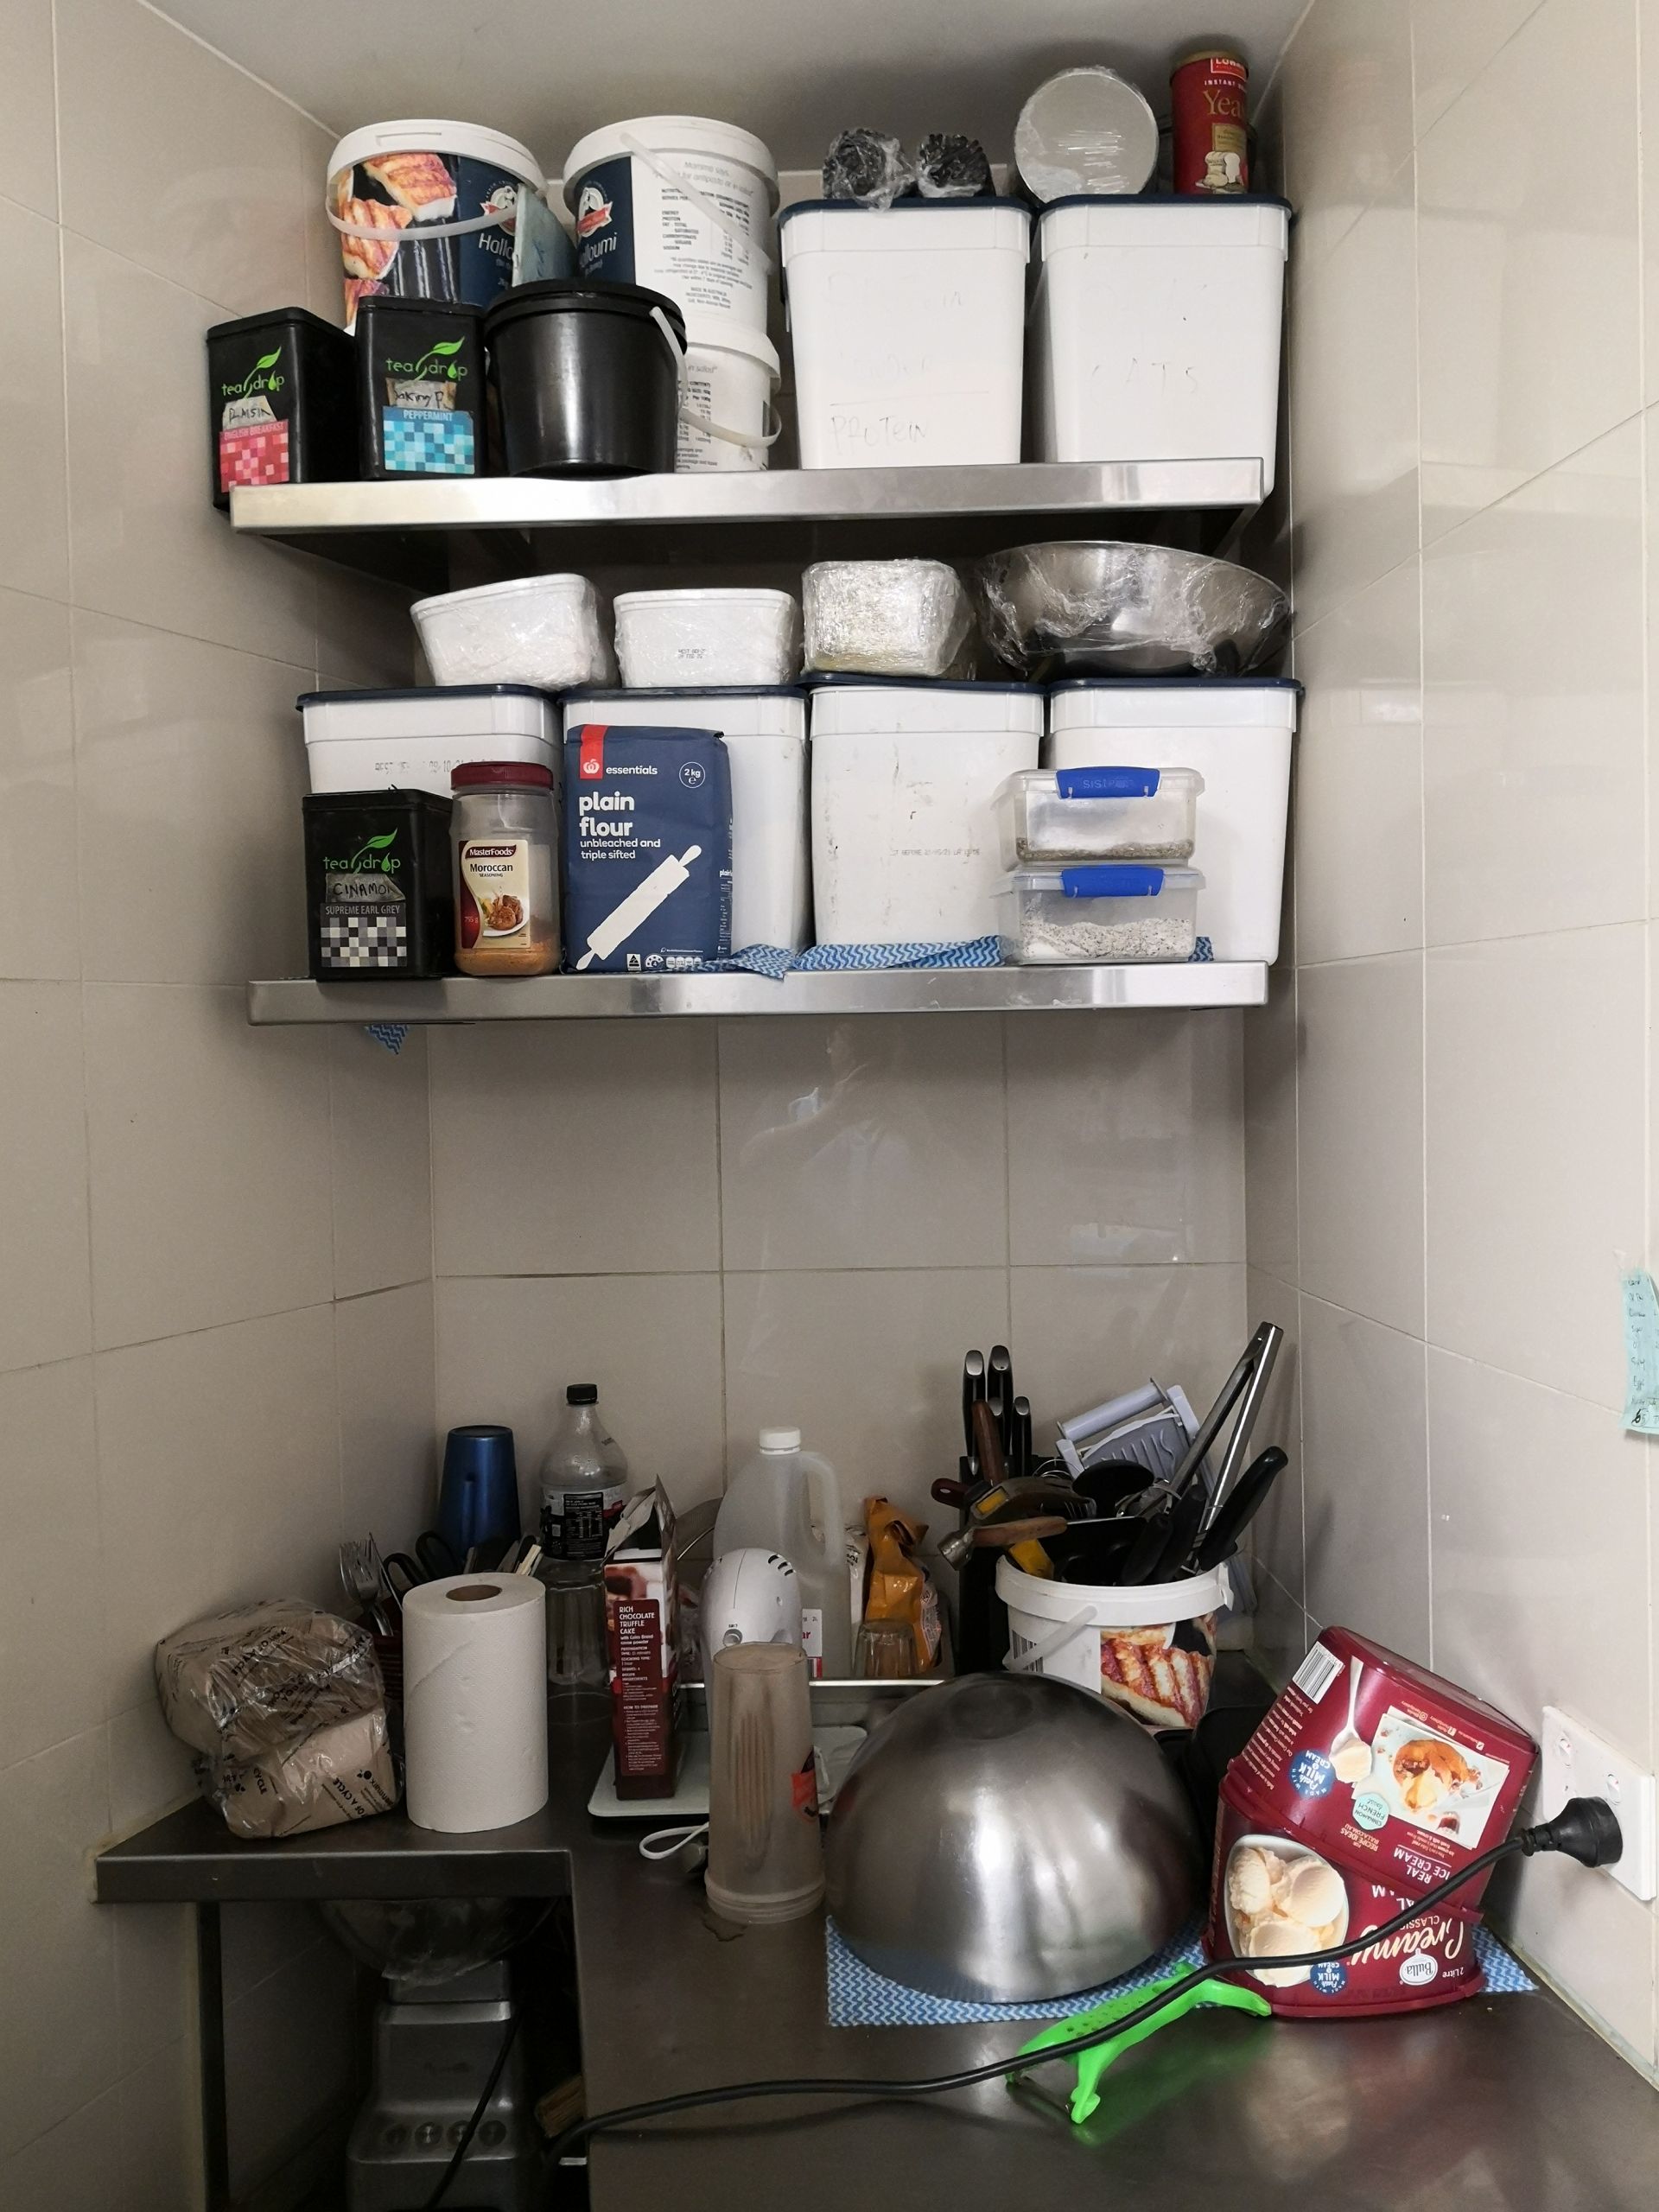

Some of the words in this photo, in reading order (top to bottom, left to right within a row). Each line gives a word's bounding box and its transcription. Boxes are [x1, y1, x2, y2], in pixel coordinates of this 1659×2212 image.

[1203, 90, 1244, 118] Yea
[403, 410, 454, 422] PEPPERMINT
[605, 765, 658, 775] essentials
[691, 768, 701, 779] kg
[579, 791, 635, 817] plain
[579, 817, 633, 836] flour
[469, 847, 514, 856] MasterFoods
[580, 838, 639, 848] unbleached
[639, 838, 661, 848] and
[581, 850, 607, 861] triple
[607, 850, 636, 859] sifted
[469, 862, 514, 873] Moroccan
[325, 905, 359, 915] SUPREME
[360, 905, 379, 914] EARL
[380, 905, 401, 914] GREY
[1305, 1750, 1332, 1770] CREAM
[1298, 1762, 1326, 1784] MILK
[332, 1777, 353, 1801] CYCLE
[1354, 1808, 1383, 1827] CINNAMON
[1357, 1802, 1387, 1821] FRENCH
[1339, 1827, 1361, 1845] IDEAS
[1358, 1836, 1379, 1853] RECIPE
[1393, 1847, 1433, 1872] CREAM
[1406, 1864, 1433, 1885] REAL
[1433, 1865, 1452, 1880] ICE
[1396, 1897, 1415, 1911] AL
[1350, 1917, 1465, 1967] Creamy
[1318, 1973, 1340, 1981] MILK
[1406, 1961, 1433, 1978] Bulla
[1442, 1967, 1459, 1979] Litre
[1459, 1967, 1465, 1975] 2
